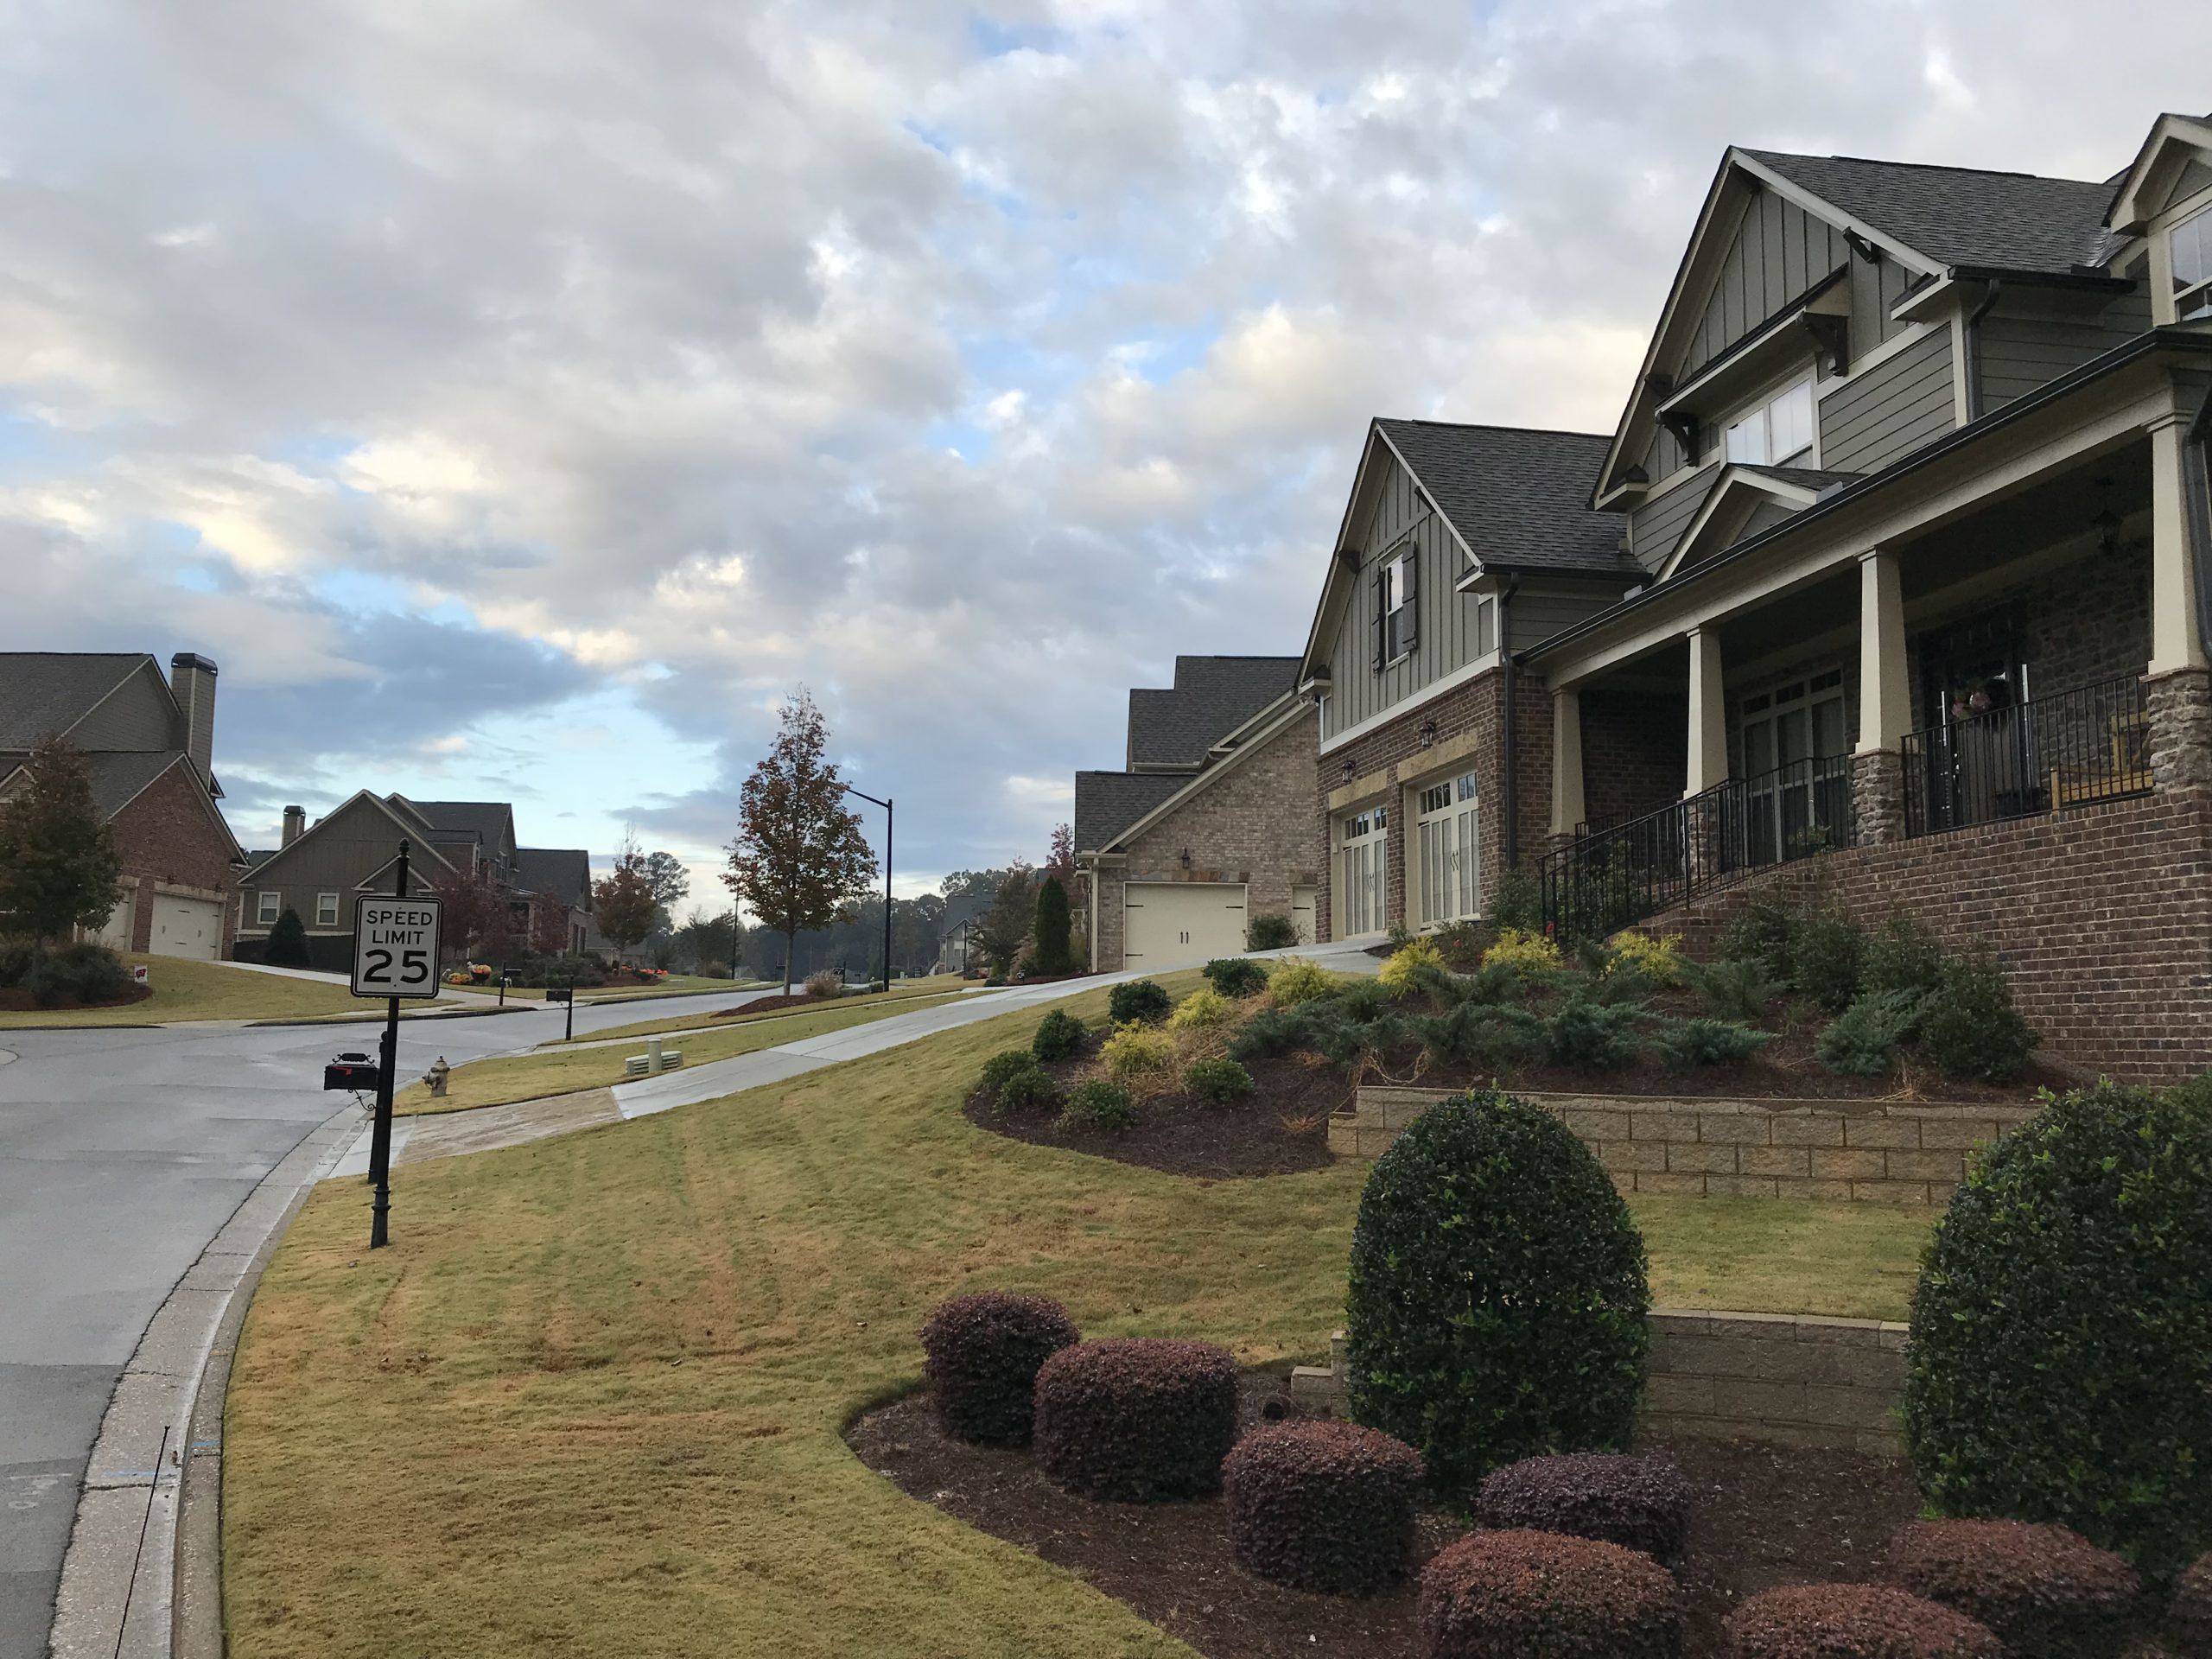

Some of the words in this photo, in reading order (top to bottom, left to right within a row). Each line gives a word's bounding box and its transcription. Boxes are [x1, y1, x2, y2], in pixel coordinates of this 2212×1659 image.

[365, 910, 433, 926] SPEED
[372, 929, 425, 945] LIMIT
[363, 949, 429, 984] 25
